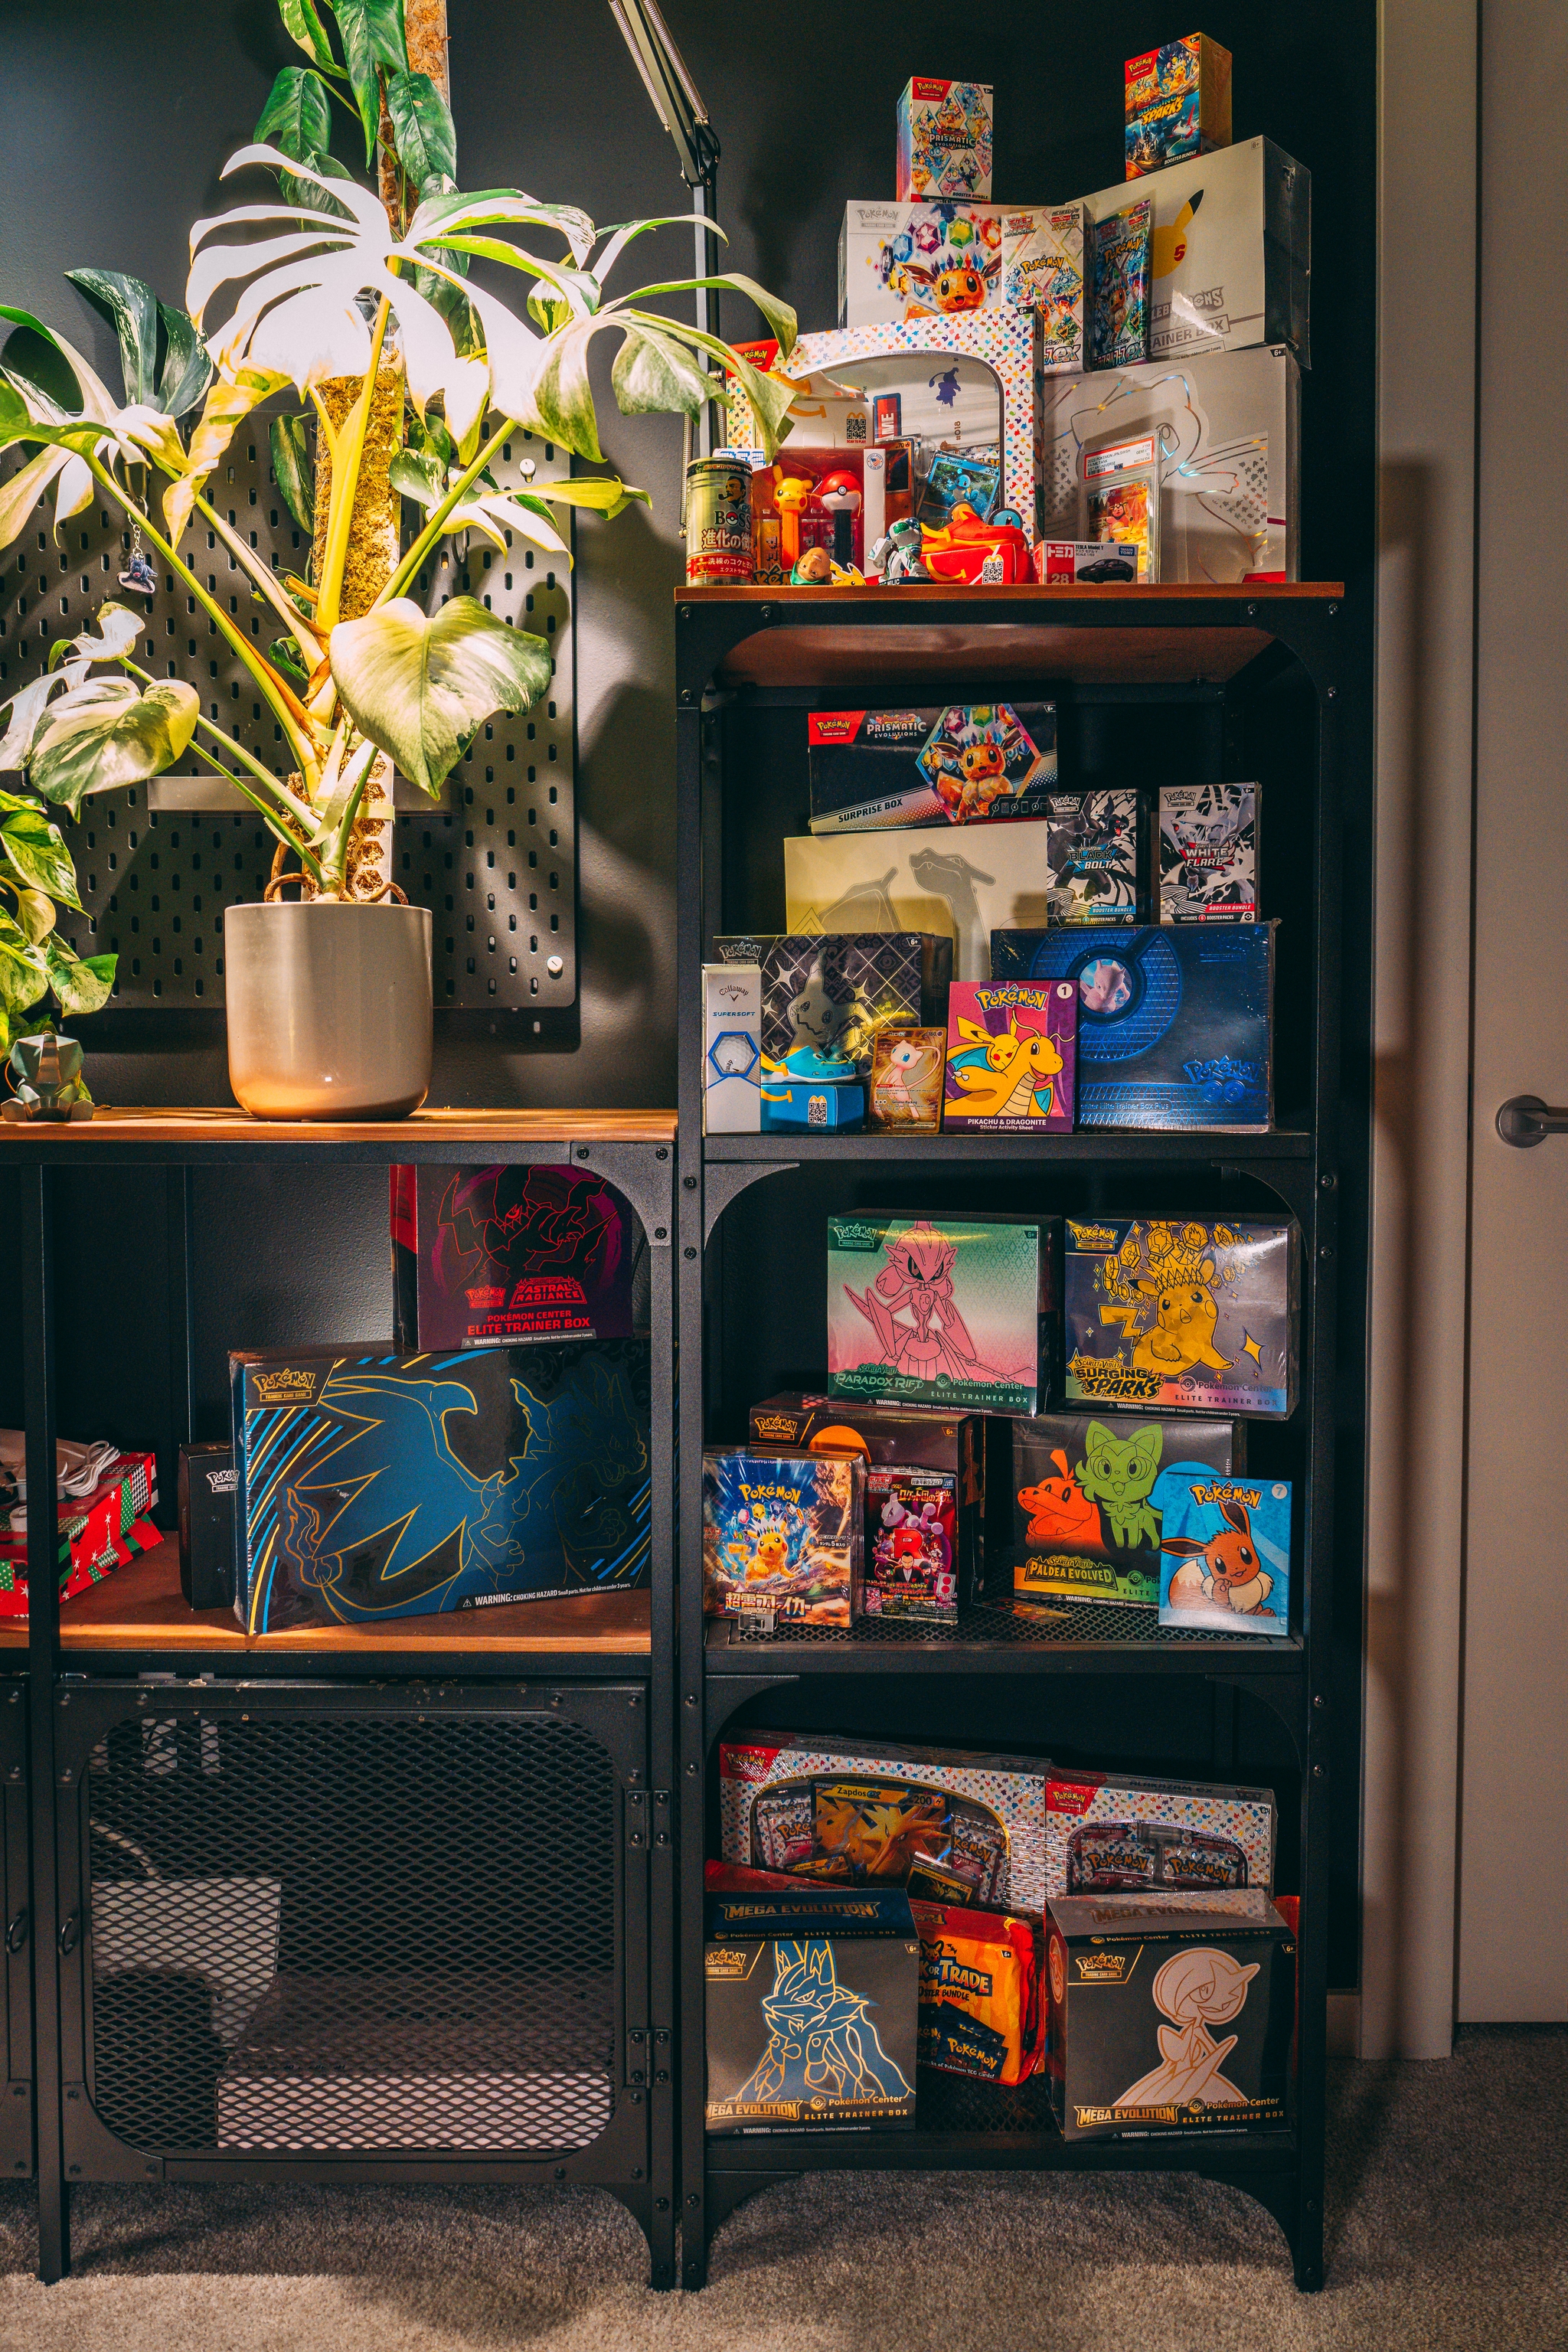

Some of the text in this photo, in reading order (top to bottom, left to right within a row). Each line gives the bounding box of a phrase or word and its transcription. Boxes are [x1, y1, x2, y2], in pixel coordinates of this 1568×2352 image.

[1142, 96, 1185, 126] SPARKS
[929, 134, 976, 145] PRISMATIC
[1165, 149, 1197, 165] BOOSTER BUNDLE
[946, 457, 963, 466] Squirtle
[1047, 546, 1074, 558] トミカ
[1051, 573, 1070, 583] 28
[867, 722, 926, 735] PRISMATIC
[838, 798, 903, 823] SURPRISE BOX
[1069, 850, 1112, 861] BLACK
[1186, 848, 1228, 858] WHITE
[1084, 861, 1112, 870] BOLT
[1186, 858, 1223, 867] FLARE
[719, 984, 749, 996] Callaway
[1200, 1080, 1246, 1104] GO
[524, 1284, 573, 1294] ASTRAL
[516, 1291, 580, 1302] RADIANCE
[487, 1310, 572, 1322] POKÉMON CENTER
[468, 1317, 591, 1335] ELITE TRAINER BOX
[1076, 1359, 1121, 1368] SCARLET VIOLET
[1075, 1367, 1148, 1379] SURGING
[835, 1373, 922, 1390] PARADOX RIFT
[952, 1378, 1024, 1390] Pokémon Center
[1083, 1375, 1165, 1400] SPARKS
[1198, 1380, 1274, 1393] Pokémon Center
[962, 1393, 1004, 1402] TRAINER
[1208, 1396, 1253, 1405] TRAINER
[898, 1489, 952, 1502] ロケット団の栄光
[1030, 1560, 1112, 1583] PALDEA EVOLVED
[475, 1592, 513, 1606] WARNING:
[513, 1592, 536, 1602] CHOKING
[536, 1589, 557, 1599] HAZARD
[1123, 1588, 1151, 1596] ELITE
[1066, 1595, 1093, 1603] WARNING:
[837, 1786, 866, 1798] Zapdos
[1129, 1780, 1193, 1792] ALAKAZAM
[914, 1795, 933, 1805] 200
[730, 1903, 875, 1919] MEGA EVOLUTION
[1097, 1908, 1141, 1922] MEGA
[929, 1959, 989, 1994] OR TRADE
[942, 1988, 970, 2001] BUNDLE
[948, 2037, 998, 2070] Pokémon
[944, 2062, 966, 2073] Pokémon
[978, 2070, 995, 2079] cards!
[828, 2095, 903, 2106] Pokémon Center
[1207, 2097, 1279, 2110] Pokémon Center
[736, 2103, 798, 2118] EVOLUTION
[839, 2110, 884, 2118] TRAINER
[1080, 2105, 1175, 2122] MEGA EVOLUTION
[1217, 2113, 1261, 2122] TRAINER
